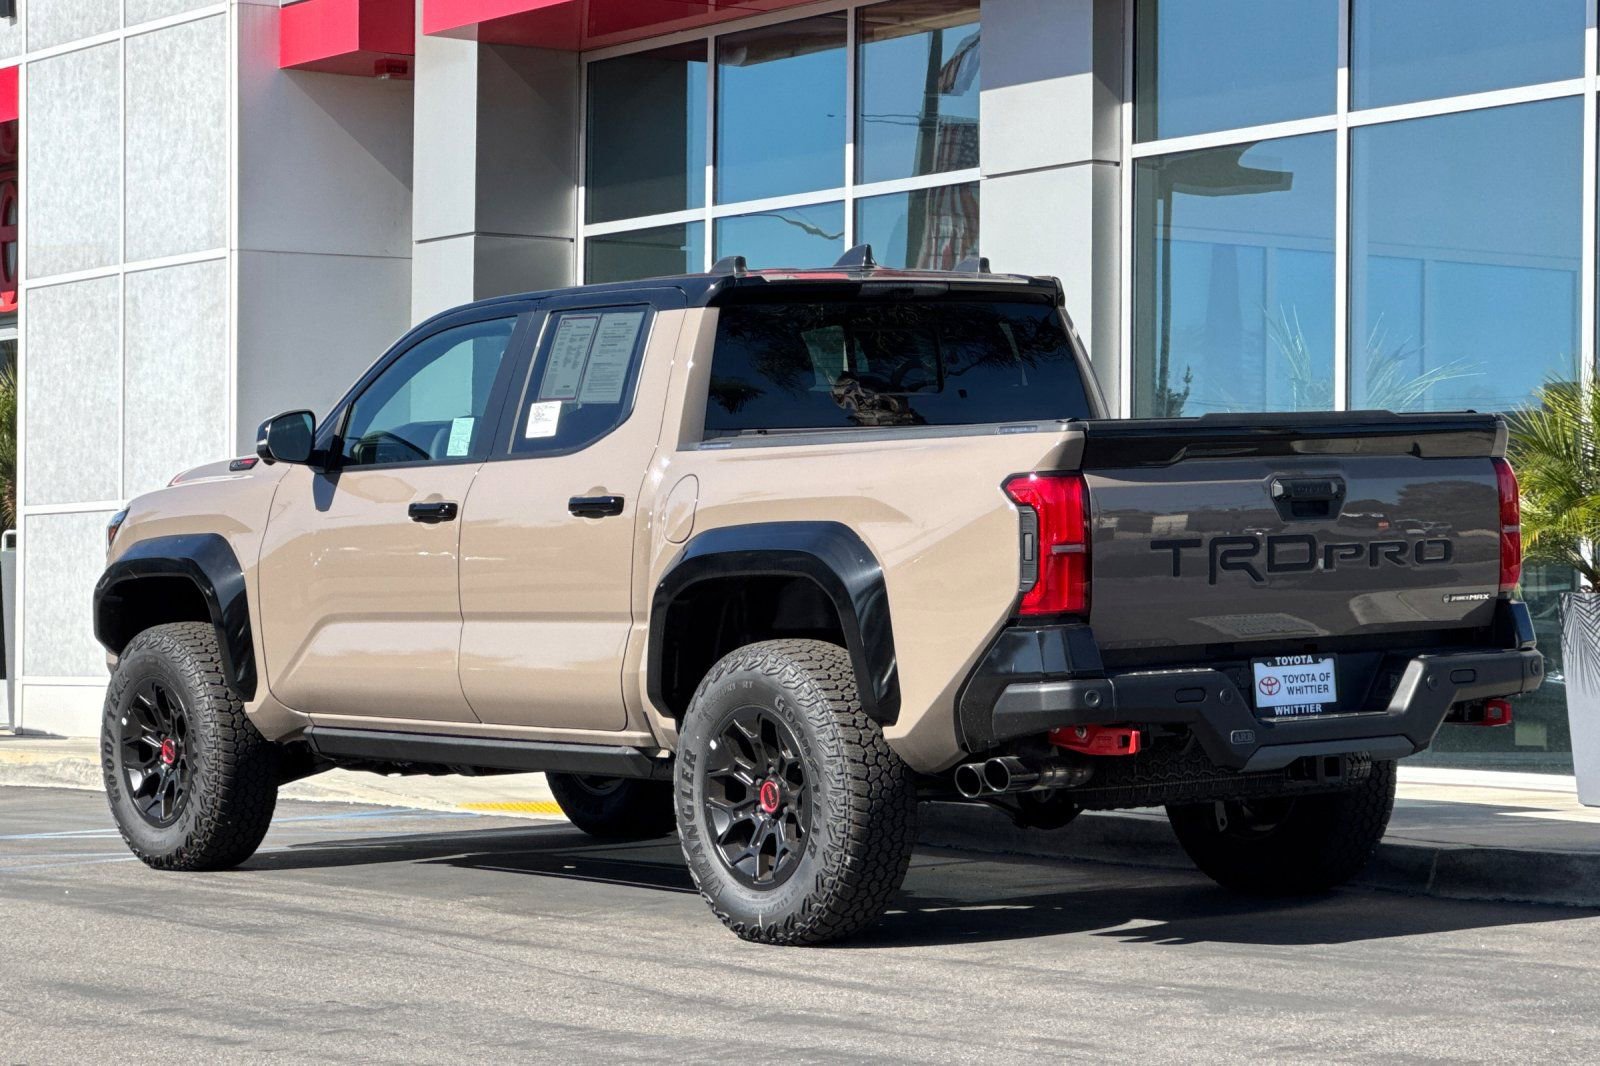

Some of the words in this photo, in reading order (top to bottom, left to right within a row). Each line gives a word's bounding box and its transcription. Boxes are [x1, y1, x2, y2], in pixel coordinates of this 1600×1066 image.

[1150, 534, 1317, 585] TRD
[1323, 539, 1452, 570] PRO
[1275, 655, 1314, 666] TOYOTA
[1282, 673, 1317, 684] TOYOTA
[1318, 672, 1331, 682] OF
[1286, 684, 1330, 696] WHITTIER
[1274, 703, 1323, 716] WHITTIER
[1233, 732, 1253, 742] ARB
[681, 748, 725, 897] WRANGLER
